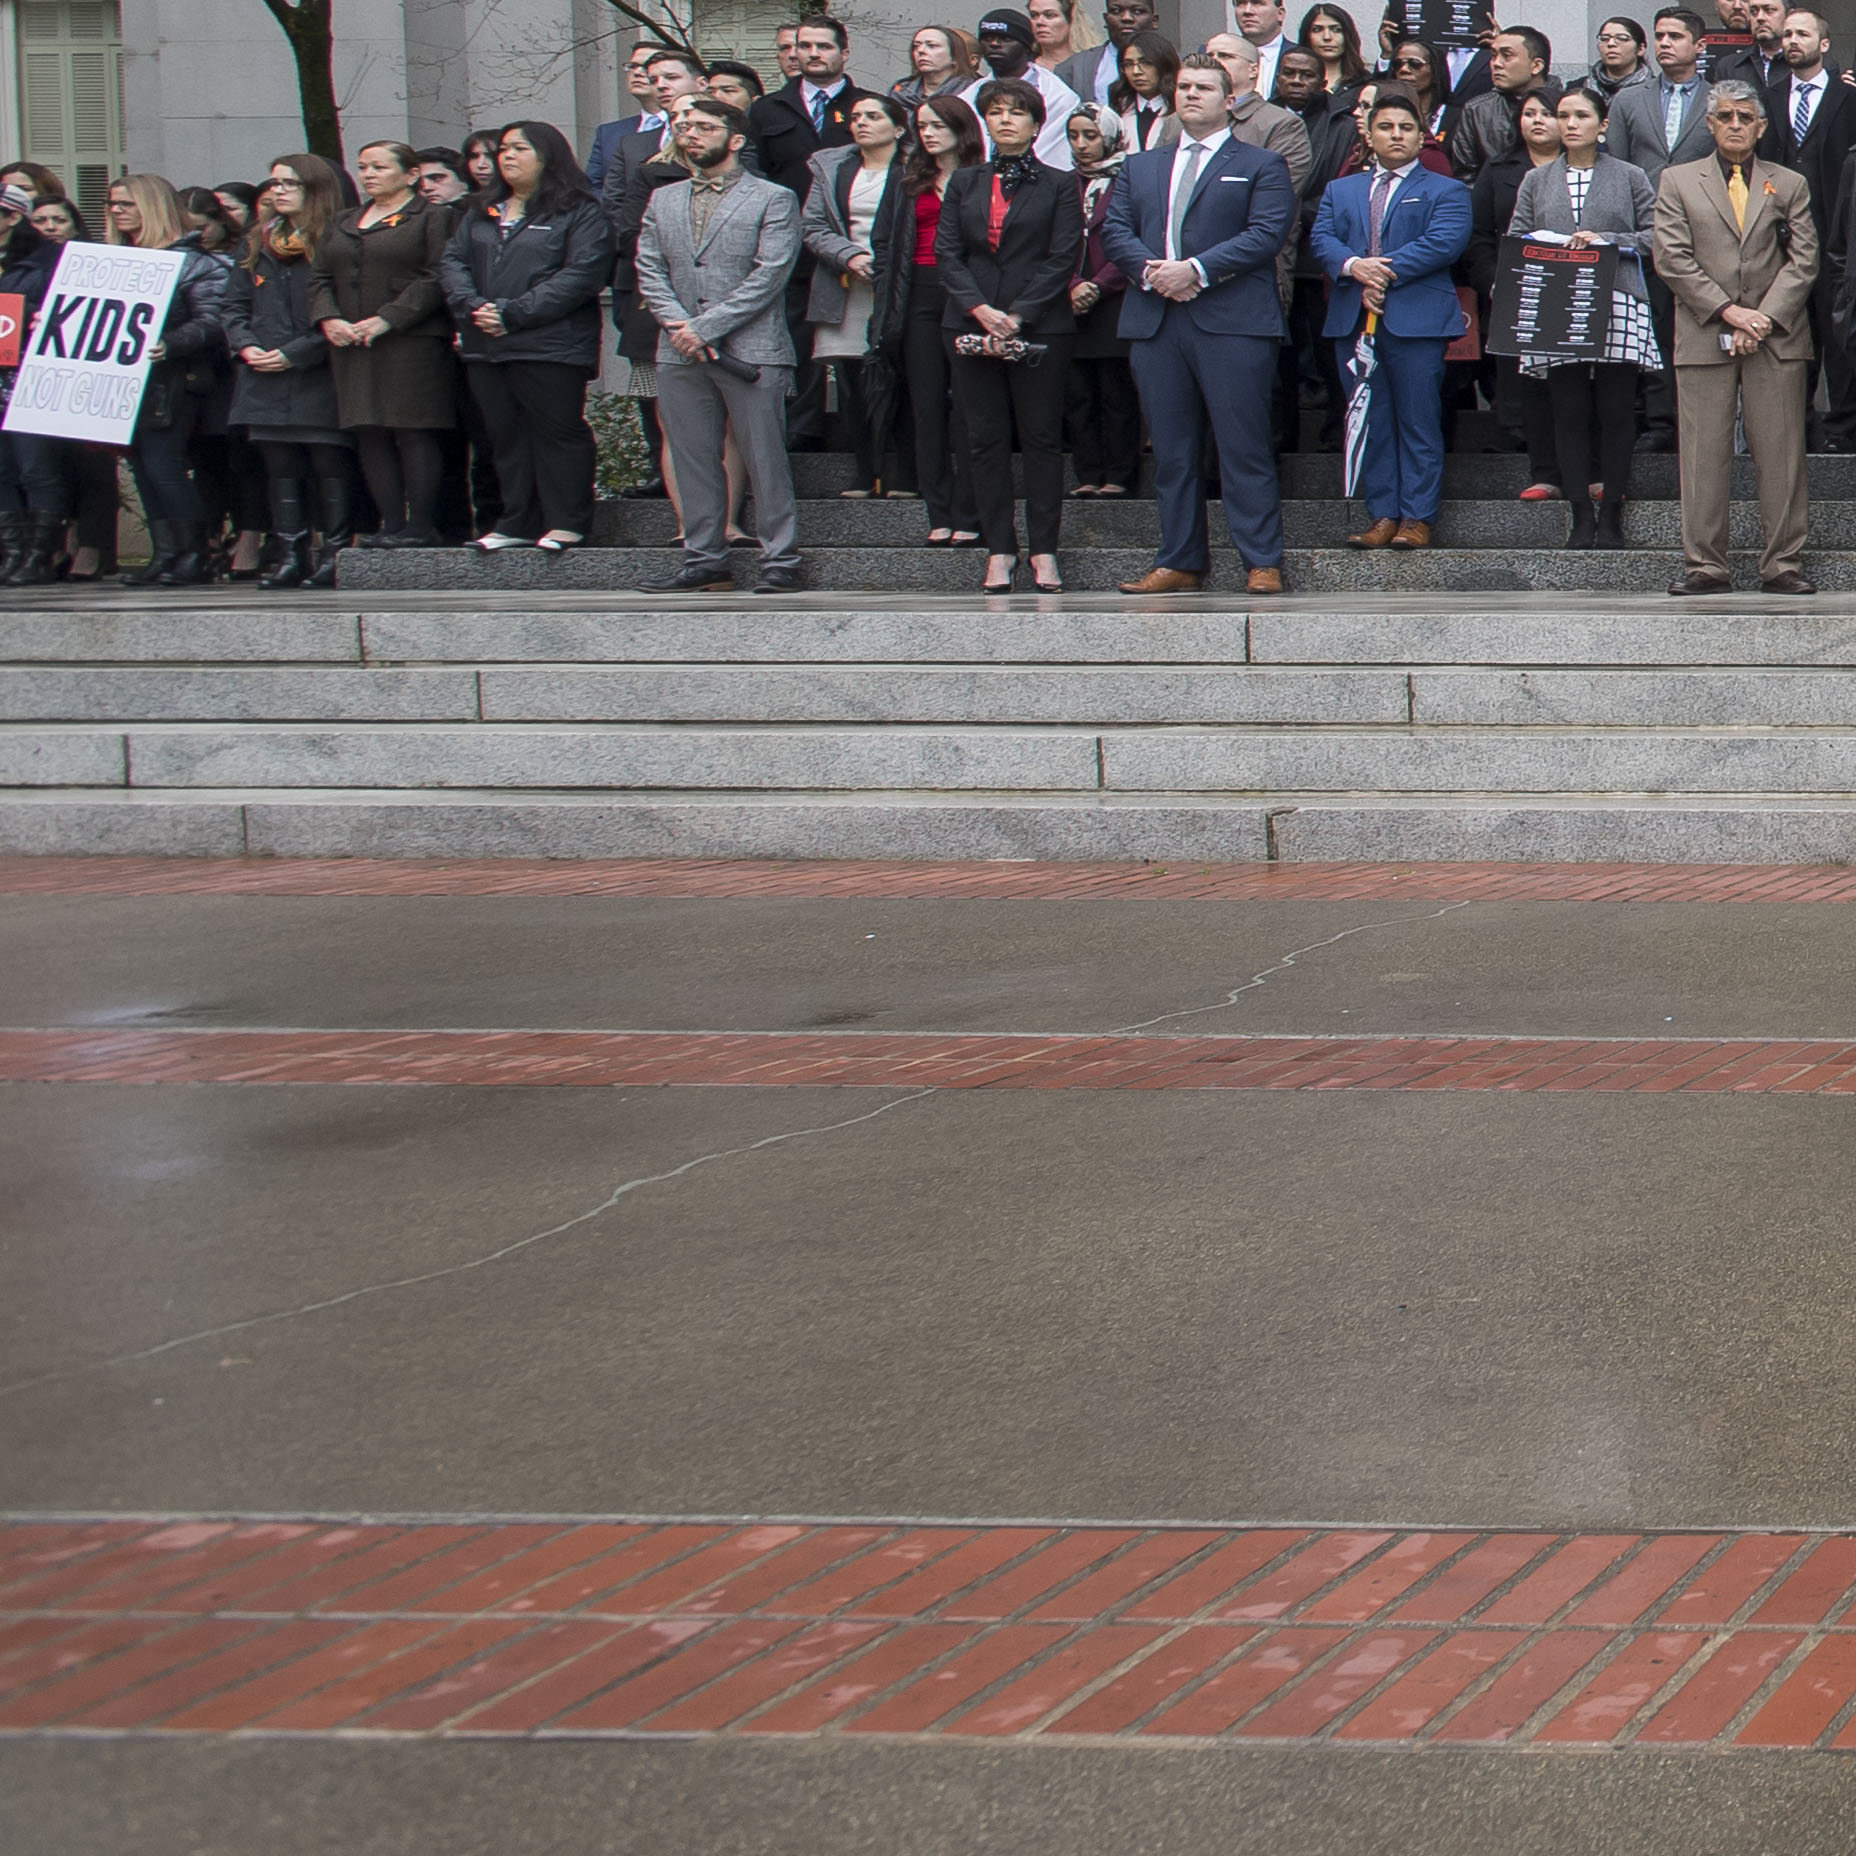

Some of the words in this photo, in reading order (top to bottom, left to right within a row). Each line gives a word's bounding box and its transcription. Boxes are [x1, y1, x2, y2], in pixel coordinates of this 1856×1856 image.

[60, 253, 175, 295] PROTECT
[35, 294, 155, 366] KIDS
[14, 365, 74, 411] NOT
[69, 371, 141, 421] GUNS
